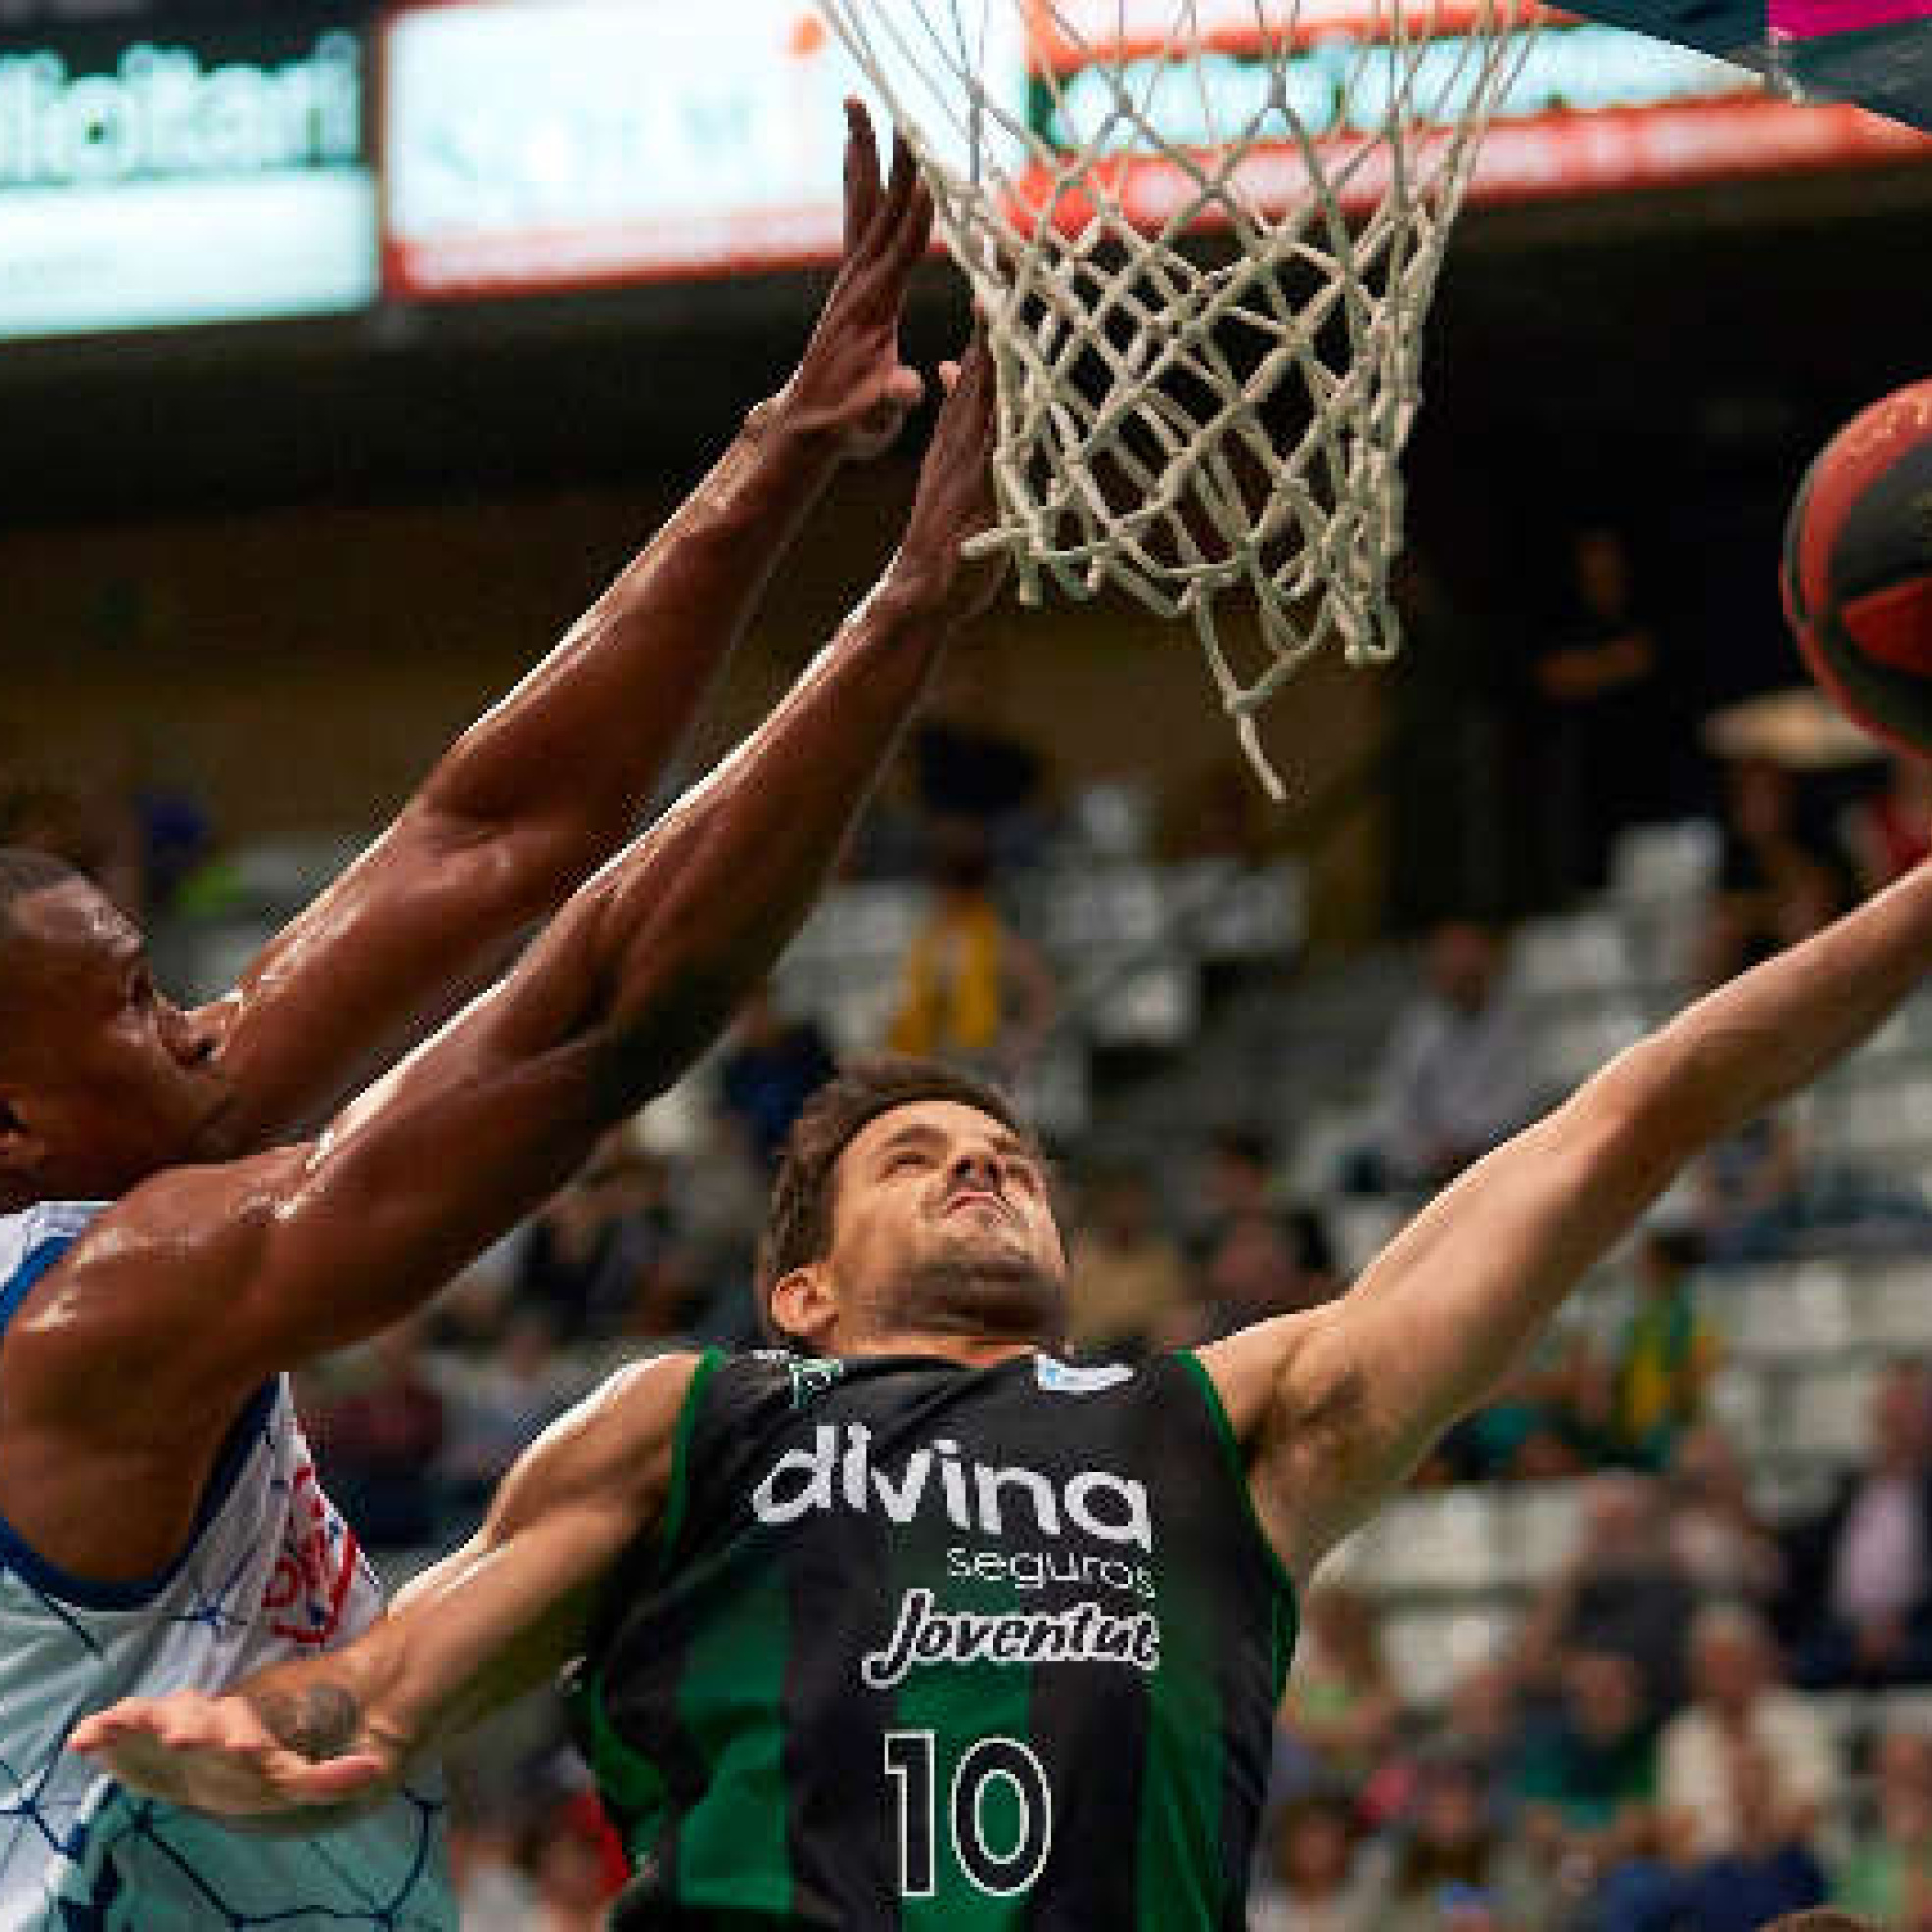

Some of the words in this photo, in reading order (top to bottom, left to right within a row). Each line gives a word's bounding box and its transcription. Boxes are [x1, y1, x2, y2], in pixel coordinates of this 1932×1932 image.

[752, 1422, 1153, 1553] divina
[947, 1547, 1156, 1598] seguros
[861, 1588, 1160, 1689] Joventut
[885, 1729, 1052, 1897] 10
